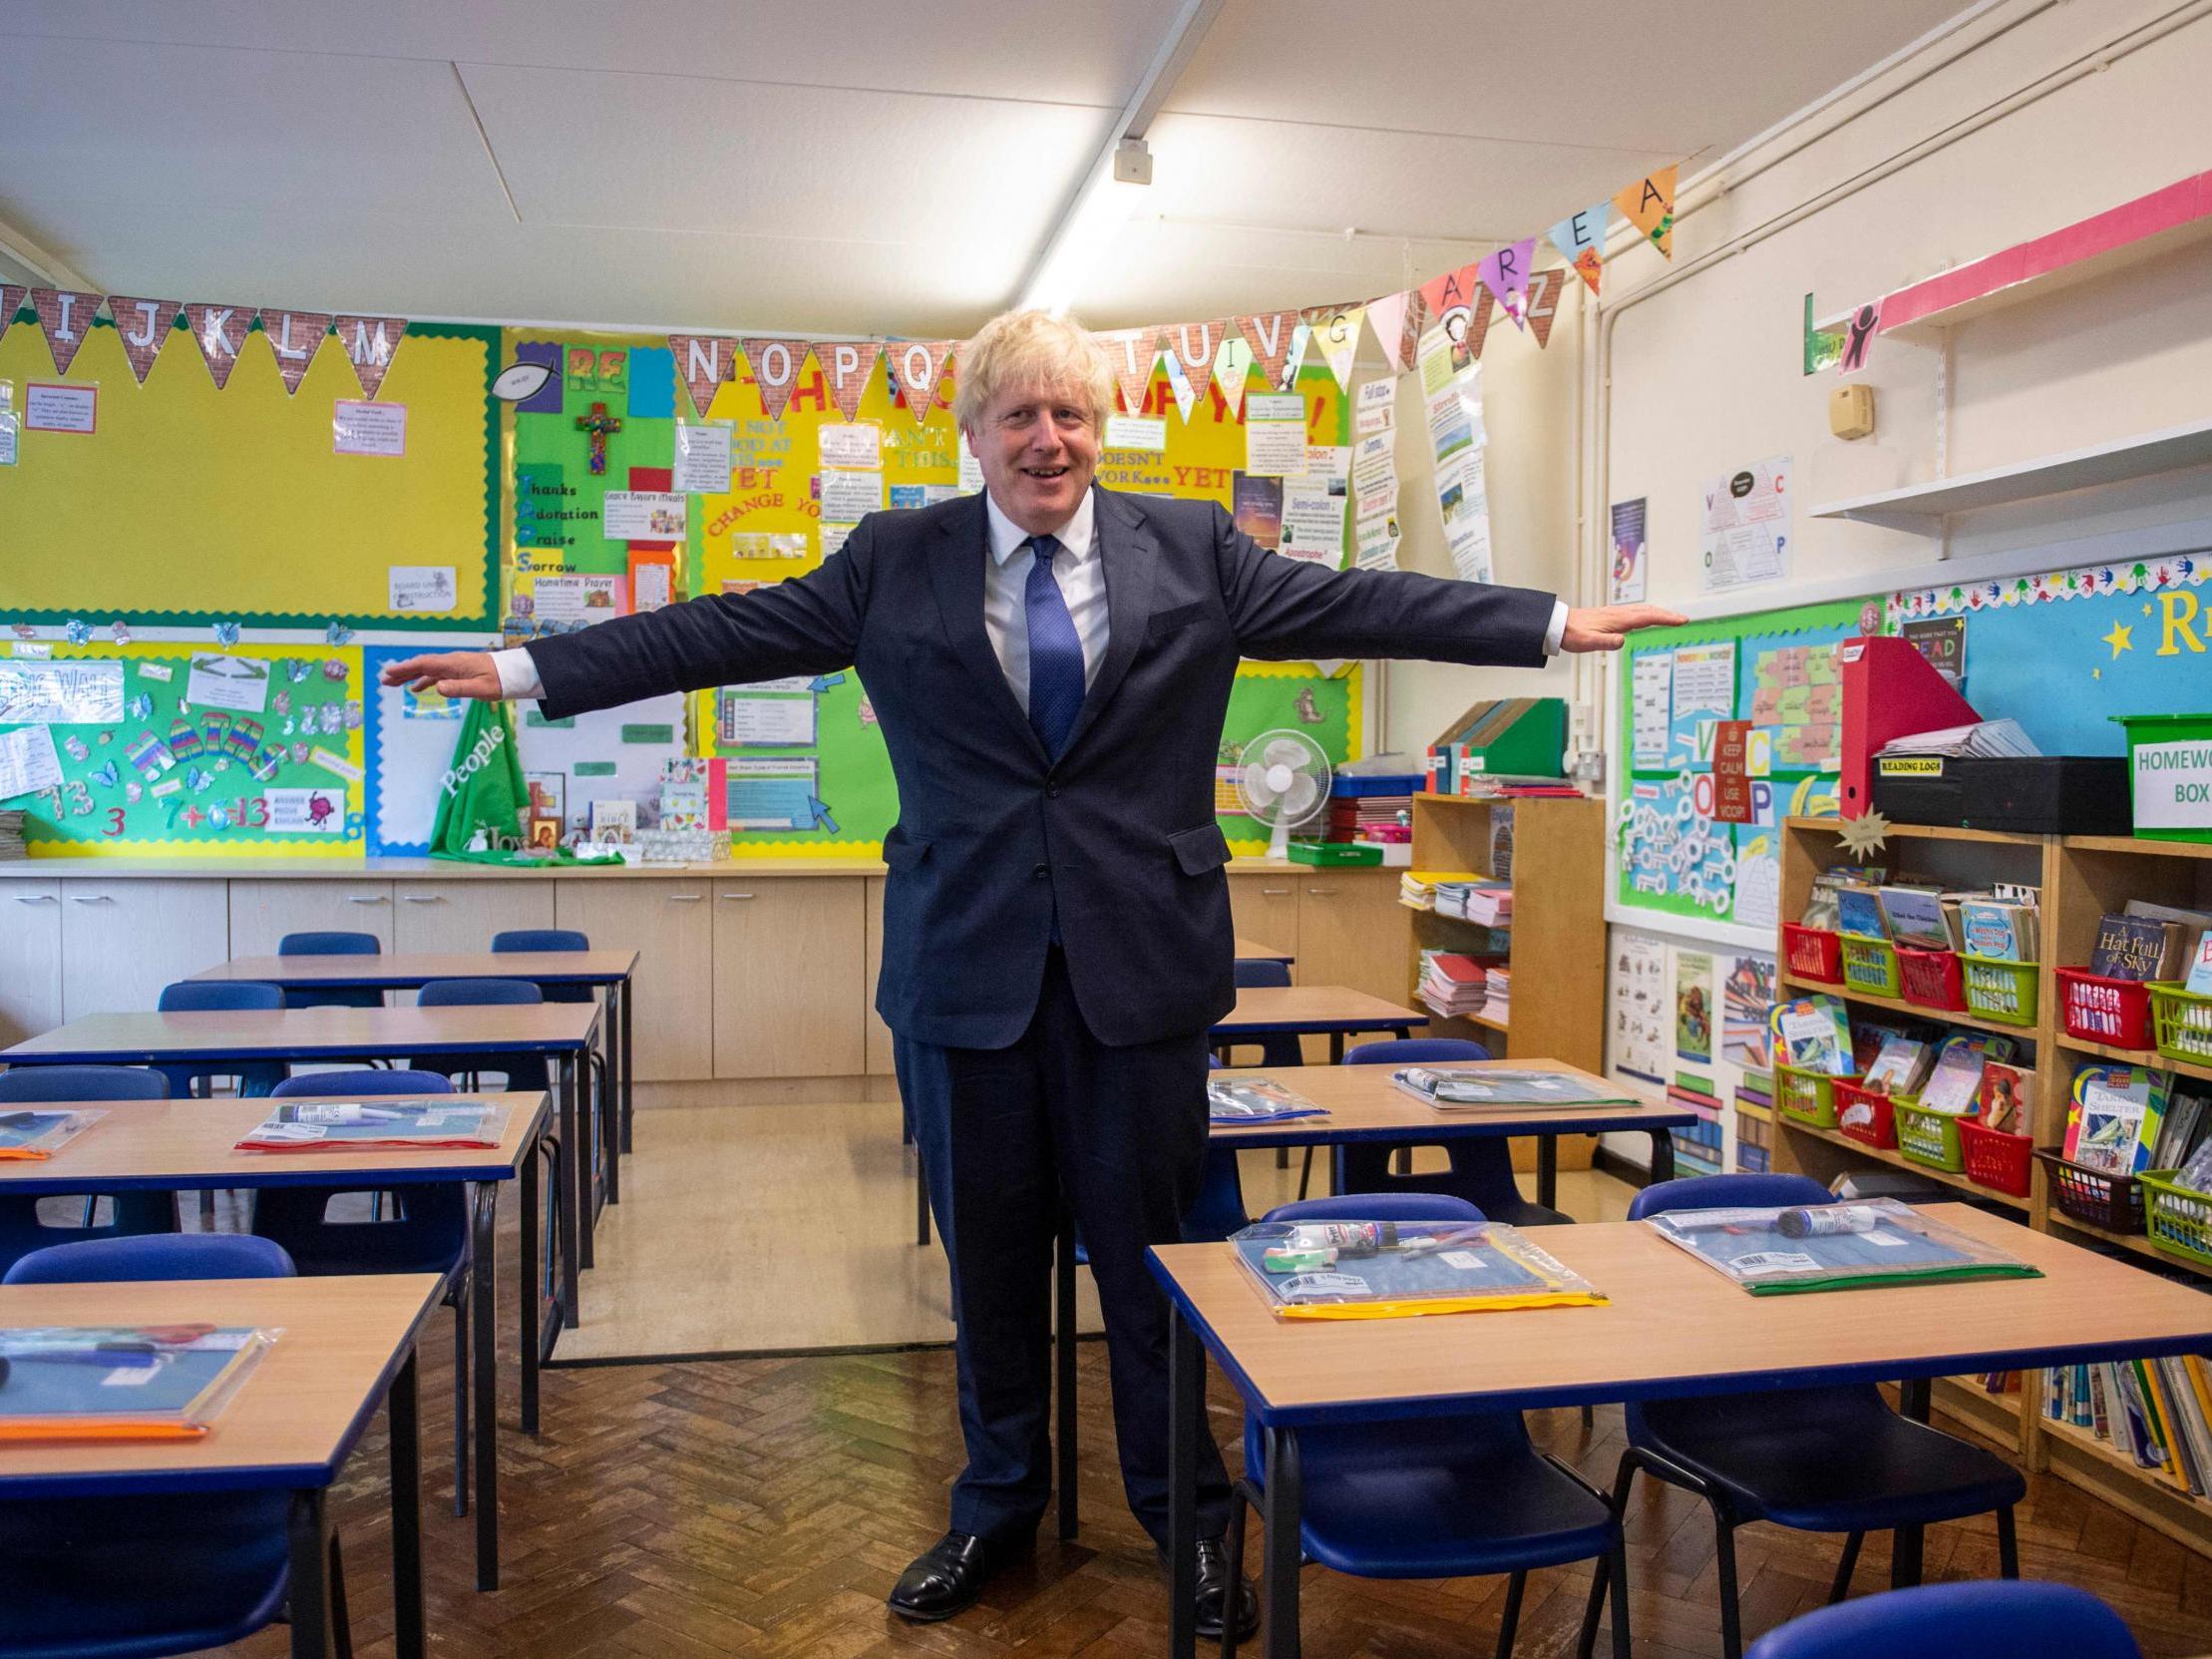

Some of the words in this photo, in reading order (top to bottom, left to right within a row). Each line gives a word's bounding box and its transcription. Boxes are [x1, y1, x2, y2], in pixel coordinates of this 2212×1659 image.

[1641, 179, 1663, 213] A
[1572, 210, 1592, 245] E
[1498, 248, 1518, 281] R
[1442, 274, 1463, 305] A
[1526, 275, 1553, 318] Z
[55, 294, 75, 340] I
[128, 301, 160, 347] J
[204, 308, 235, 355] K
[281, 314, 307, 360] L
[353, 319, 391, 366] M
[1329, 315, 1347, 343] G
[1114, 332, 1144, 375] T
[1180, 324, 1211, 368] U
[1253, 315, 1282, 358] V
[568, 348, 626, 395] RE
[688, 340, 719, 383] N
[761, 343, 792, 387] O
[835, 346, 860, 389] P
[904, 344, 933, 391] Q
[883, 427, 947, 448] AN'T
[518, 475, 577, 497] Thanks
[1174, 465, 1232, 489] YET
[1775, 475, 1784, 494] C
[518, 499, 599, 521] Adoration
[707, 493, 784, 539] CHANGE
[519, 524, 575, 547] Praise
[1776, 536, 1785, 555] P
[517, 552, 576, 573] Sorrow
[1697, 721, 1716, 761] V
[1747, 731, 1769, 775] C
[439, 725, 506, 799] People
[1719, 761, 1744, 775] CALM
[1882, 761, 1918, 772] READING
[1919, 761, 1941, 772] LOGS
[1695, 774, 1713, 816] O
[1723, 787, 1739, 800] USE
[1751, 782, 1772, 825] P
[2175, 783, 2210, 803] BOX
[102, 807, 126, 837] 3
[2100, 932, 2130, 953] Hat
[2118, 925, 2128, 937] A
